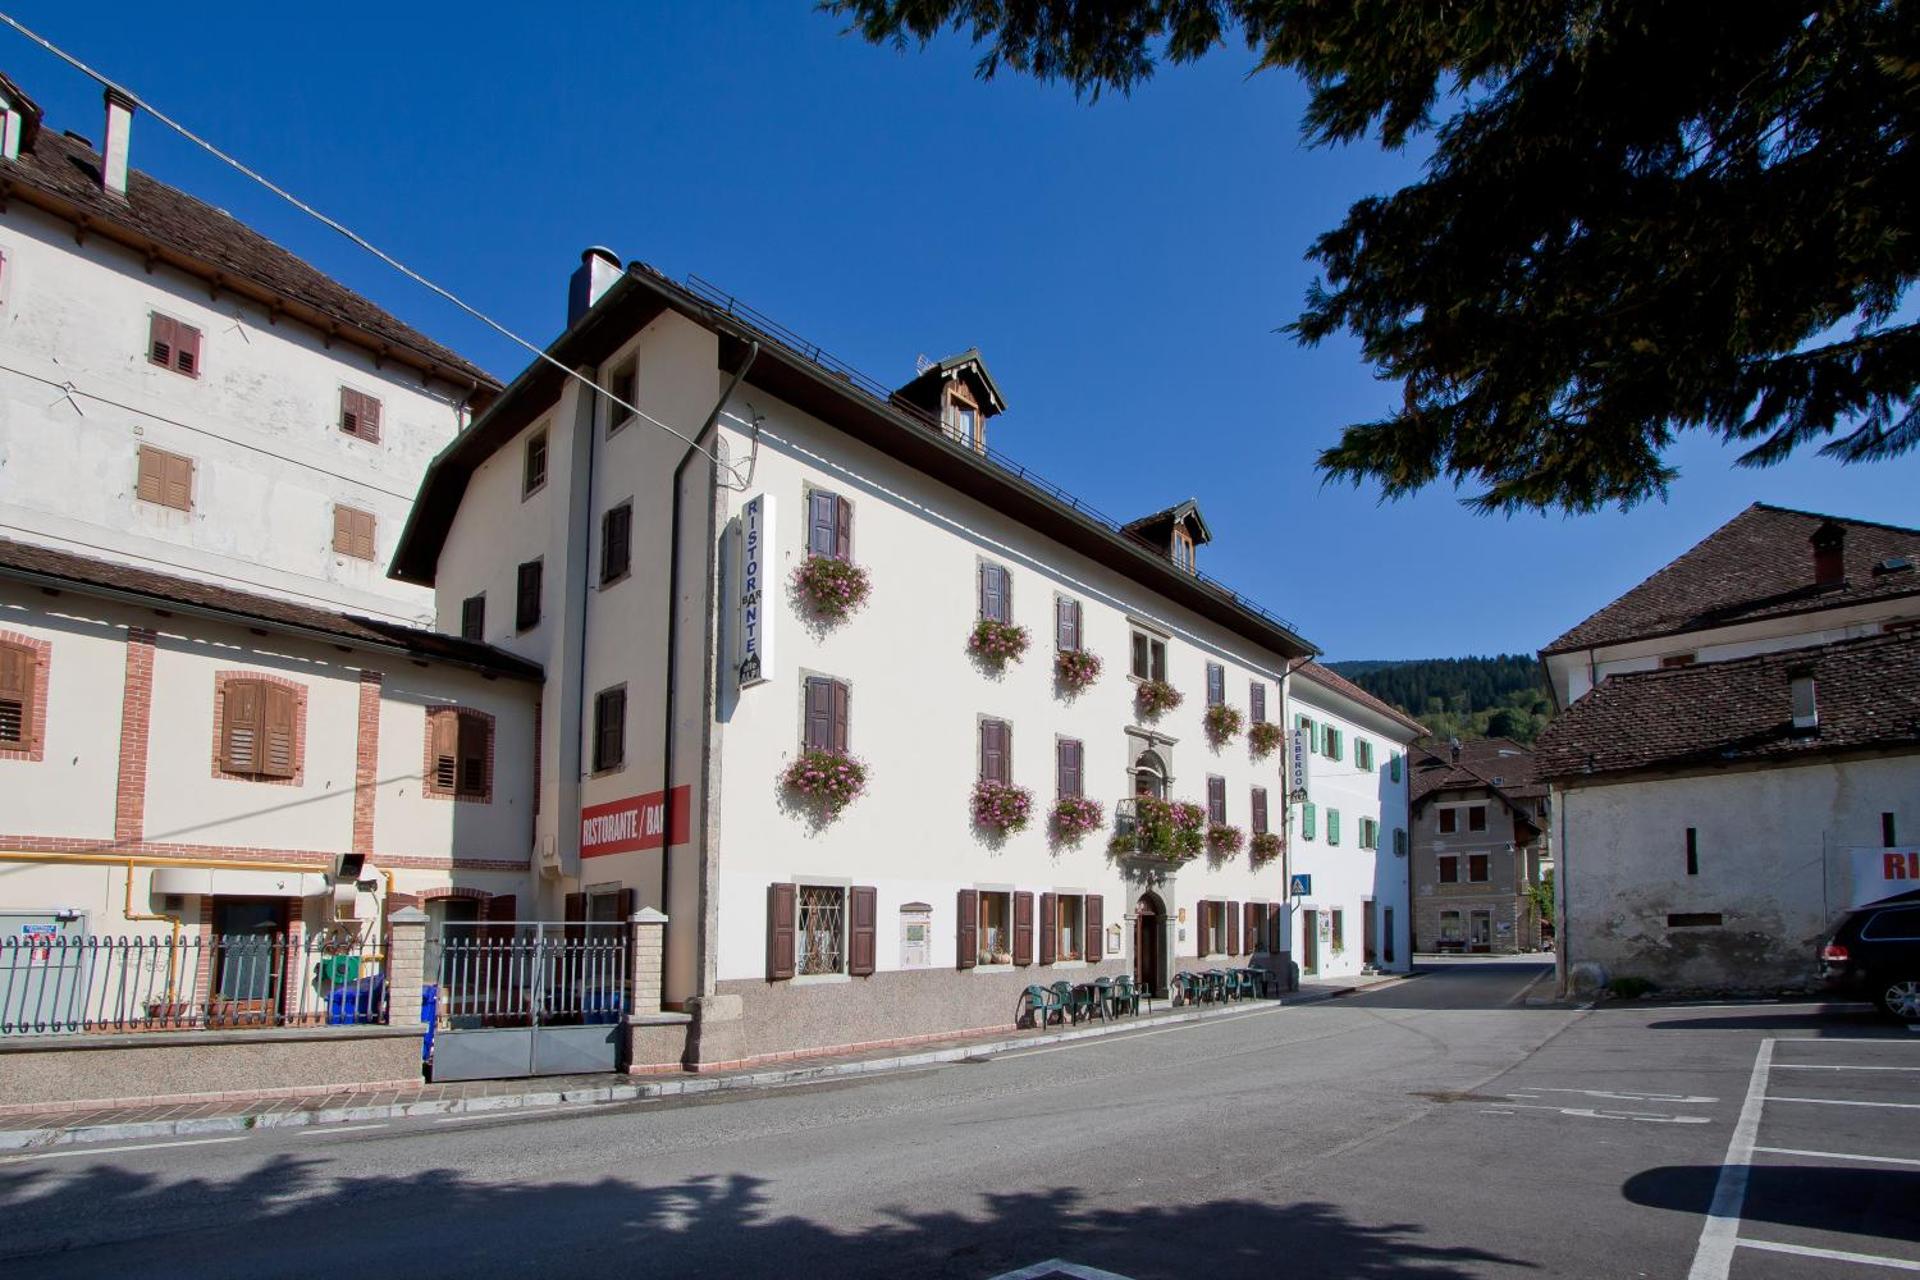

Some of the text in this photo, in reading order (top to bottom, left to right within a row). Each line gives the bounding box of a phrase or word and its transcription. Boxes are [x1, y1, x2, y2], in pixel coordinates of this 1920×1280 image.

[742, 590, 762, 607] BAR
[746, 501, 758, 653] RISTORANTE
[1295, 730, 1303, 785] ALBERGO
[583, 809, 638, 846] RISTORANTE
